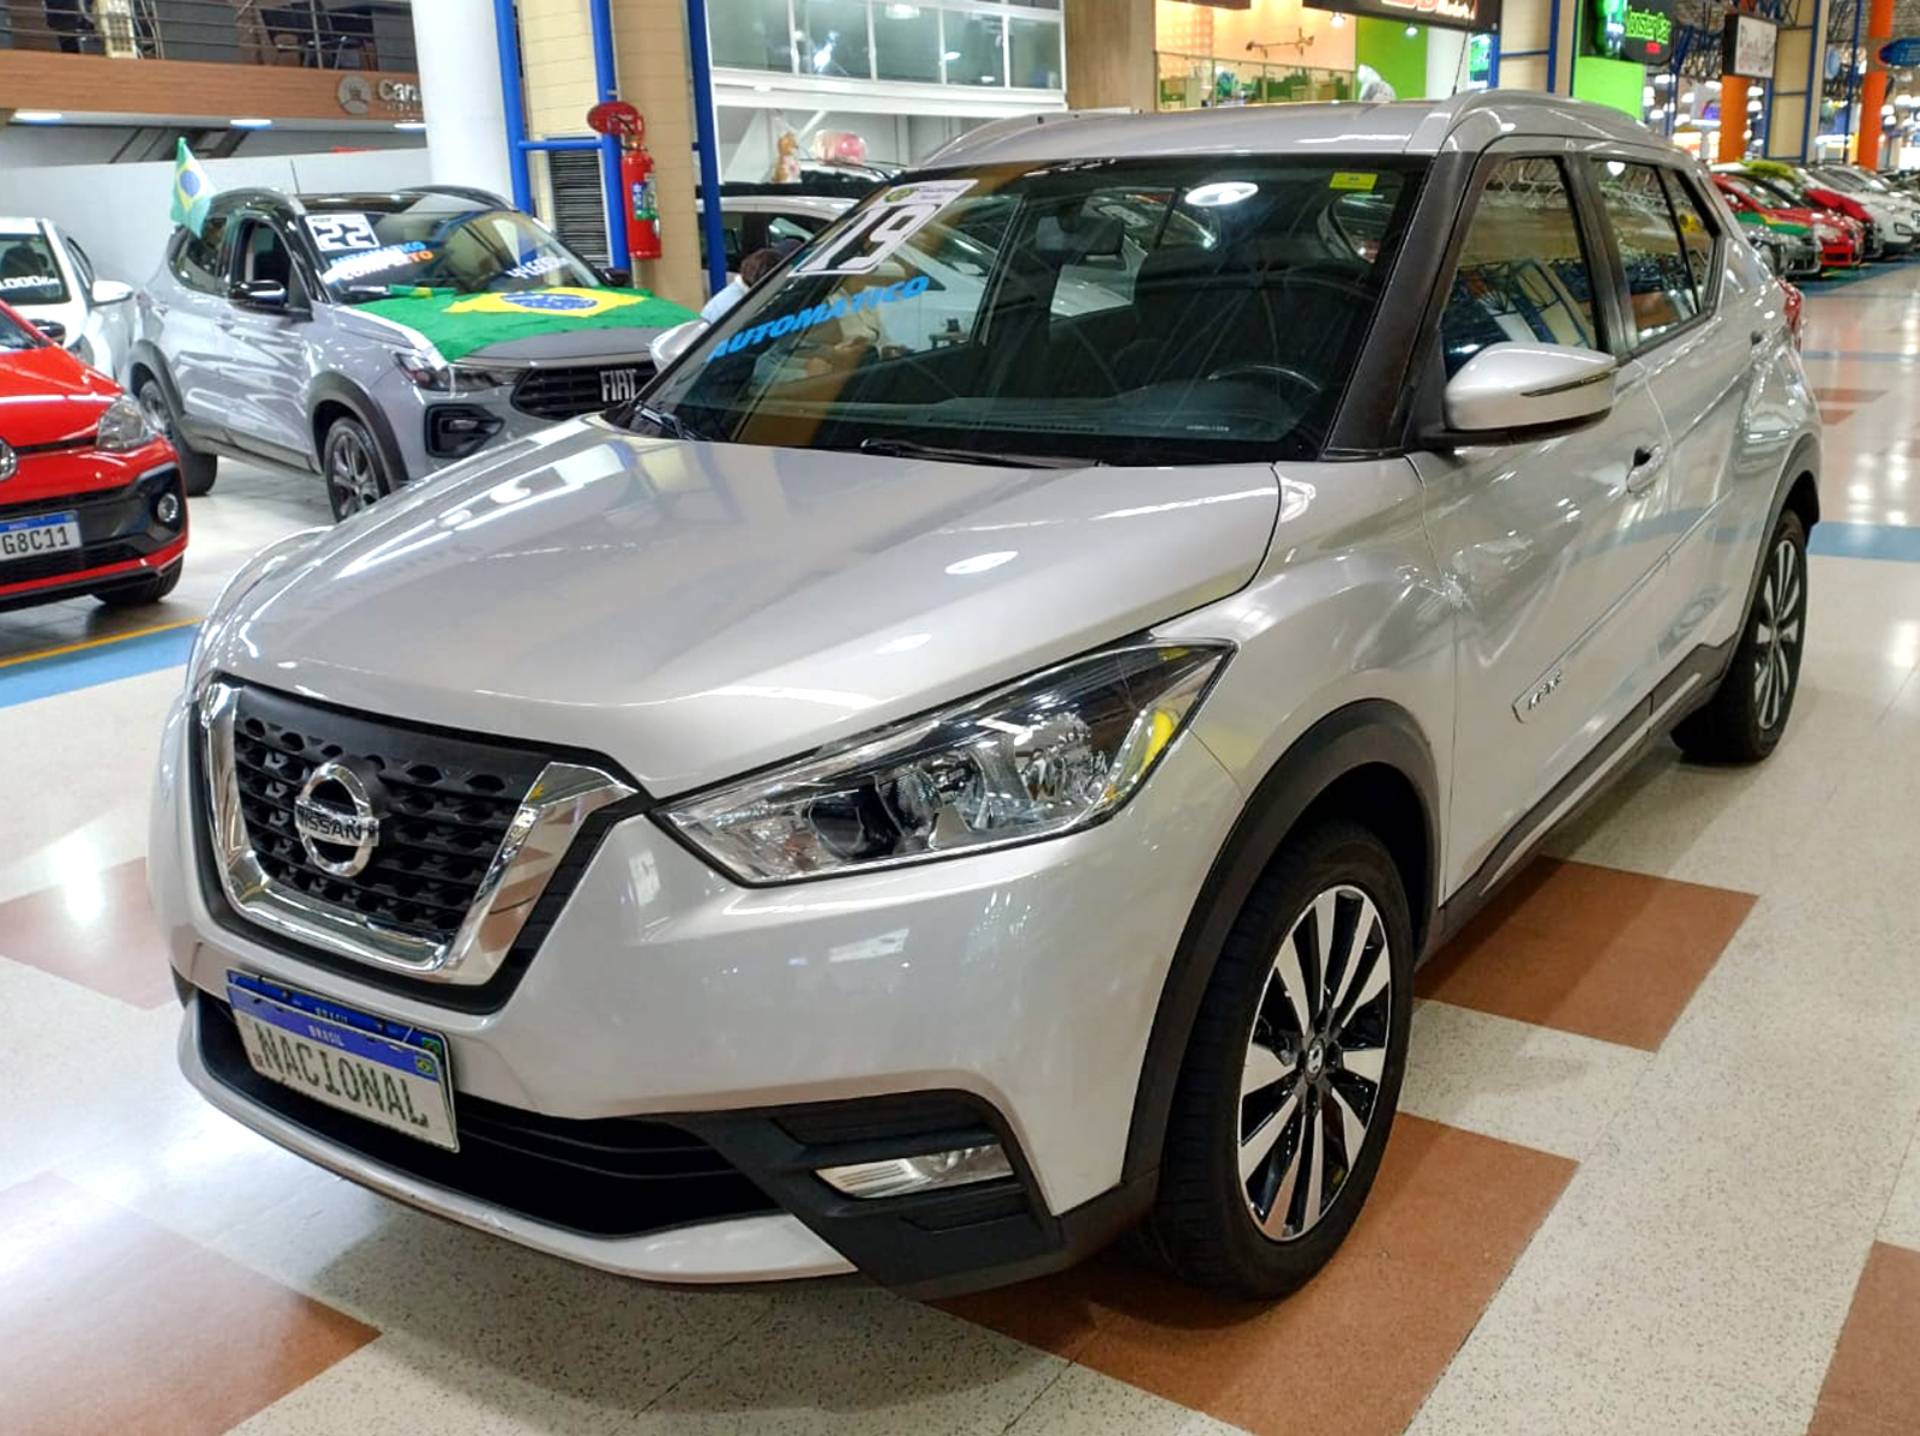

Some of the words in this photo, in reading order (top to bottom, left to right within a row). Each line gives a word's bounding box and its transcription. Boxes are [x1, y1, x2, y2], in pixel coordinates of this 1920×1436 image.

[313, 222, 376, 250] 22
[600, 368, 637, 402] FIAT
[2, 525, 71, 555] G8C11
[299, 810, 363, 840] NISSAN
[254, 1022, 430, 1129] NACIONAL
